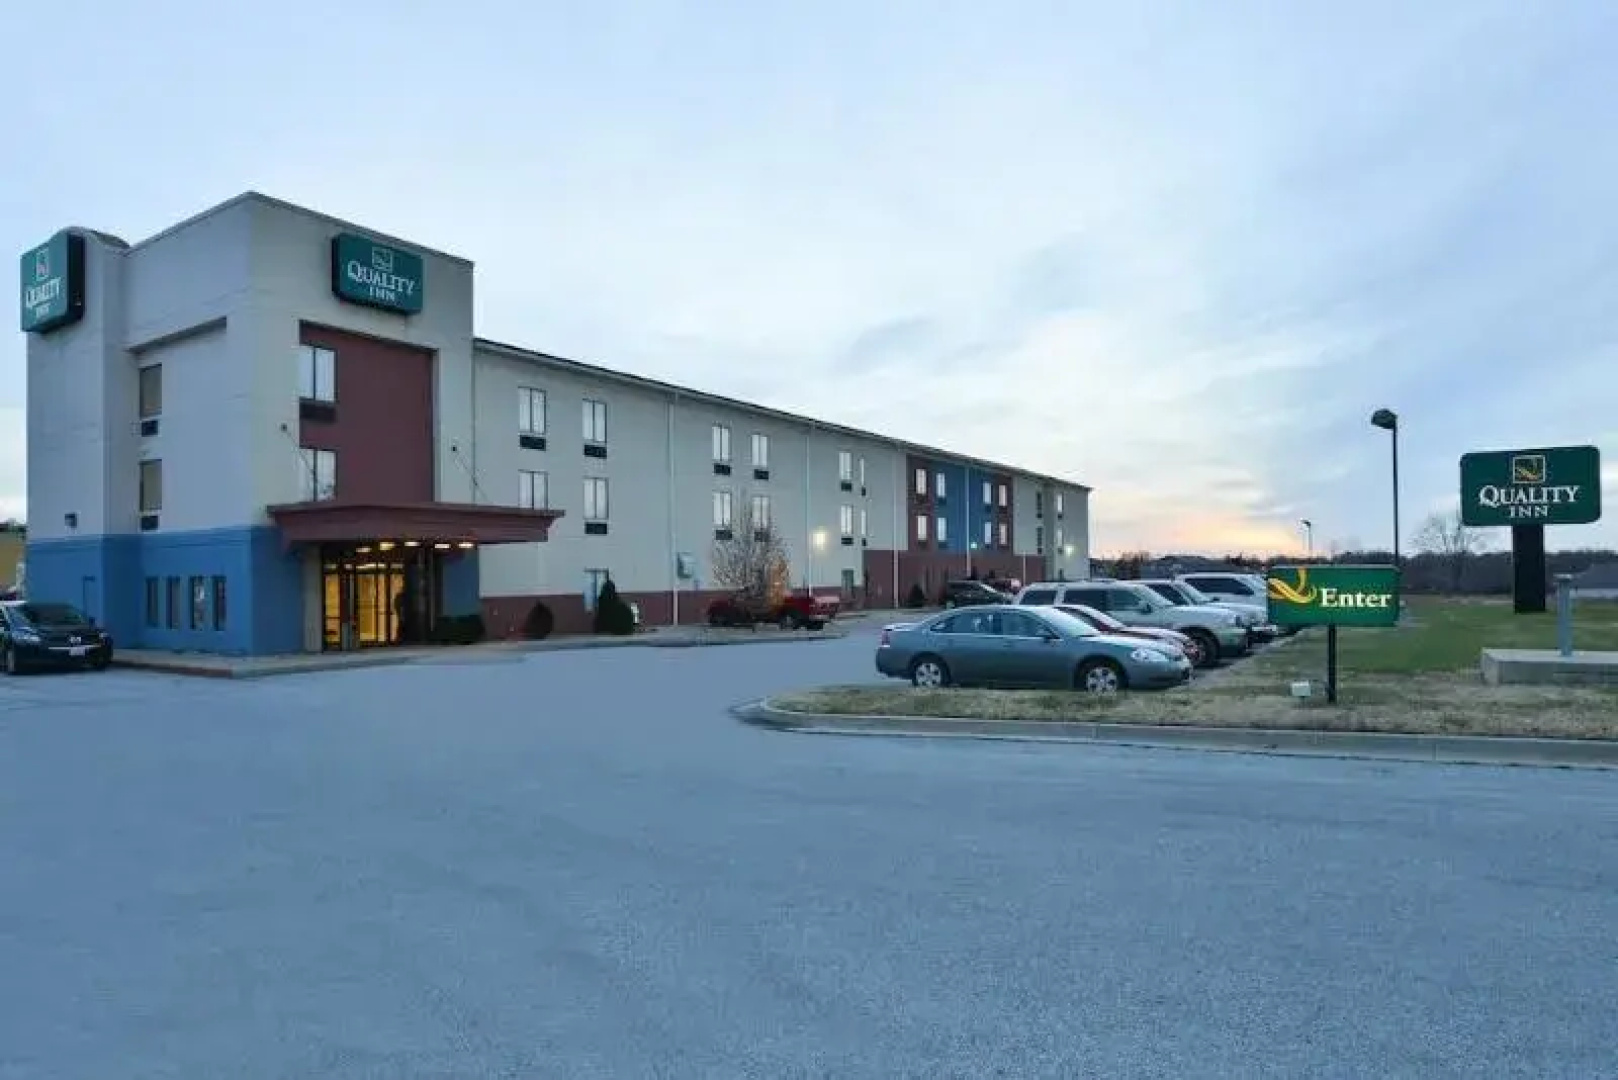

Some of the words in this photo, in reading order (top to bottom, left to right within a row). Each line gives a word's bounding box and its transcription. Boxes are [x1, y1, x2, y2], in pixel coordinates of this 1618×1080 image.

[347, 260, 415, 295] QUALITY
[369, 285, 395, 301] INN
[1479, 484, 1579, 508] QUALITY
[1508, 505, 1548, 519] INN
[1320, 587, 1392, 608] Enter
